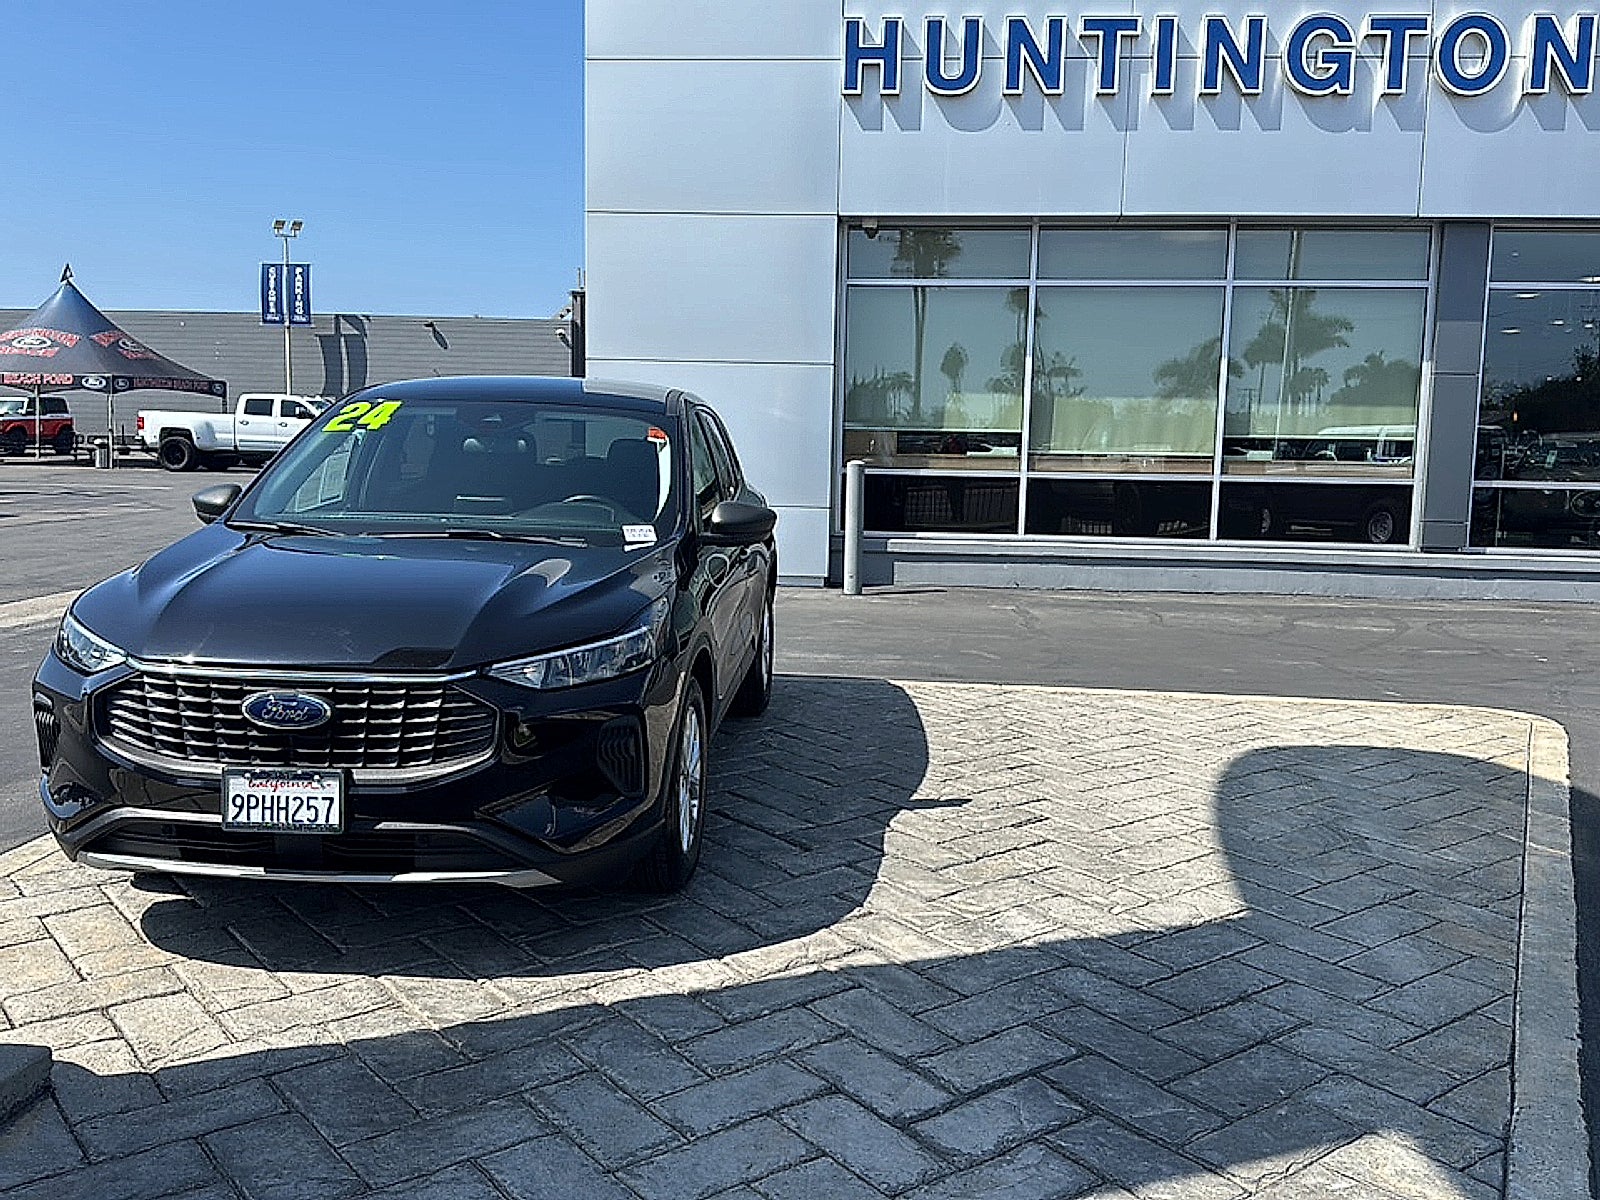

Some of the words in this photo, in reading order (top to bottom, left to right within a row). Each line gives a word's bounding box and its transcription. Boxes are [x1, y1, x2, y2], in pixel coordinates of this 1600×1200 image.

[843, 13, 1598, 96] HUNTINGTON
[321, 401, 403, 432] 24
[260, 699, 310, 721] Ford
[248, 778, 319, 792] California
[231, 793, 335, 823] 9PHH257
